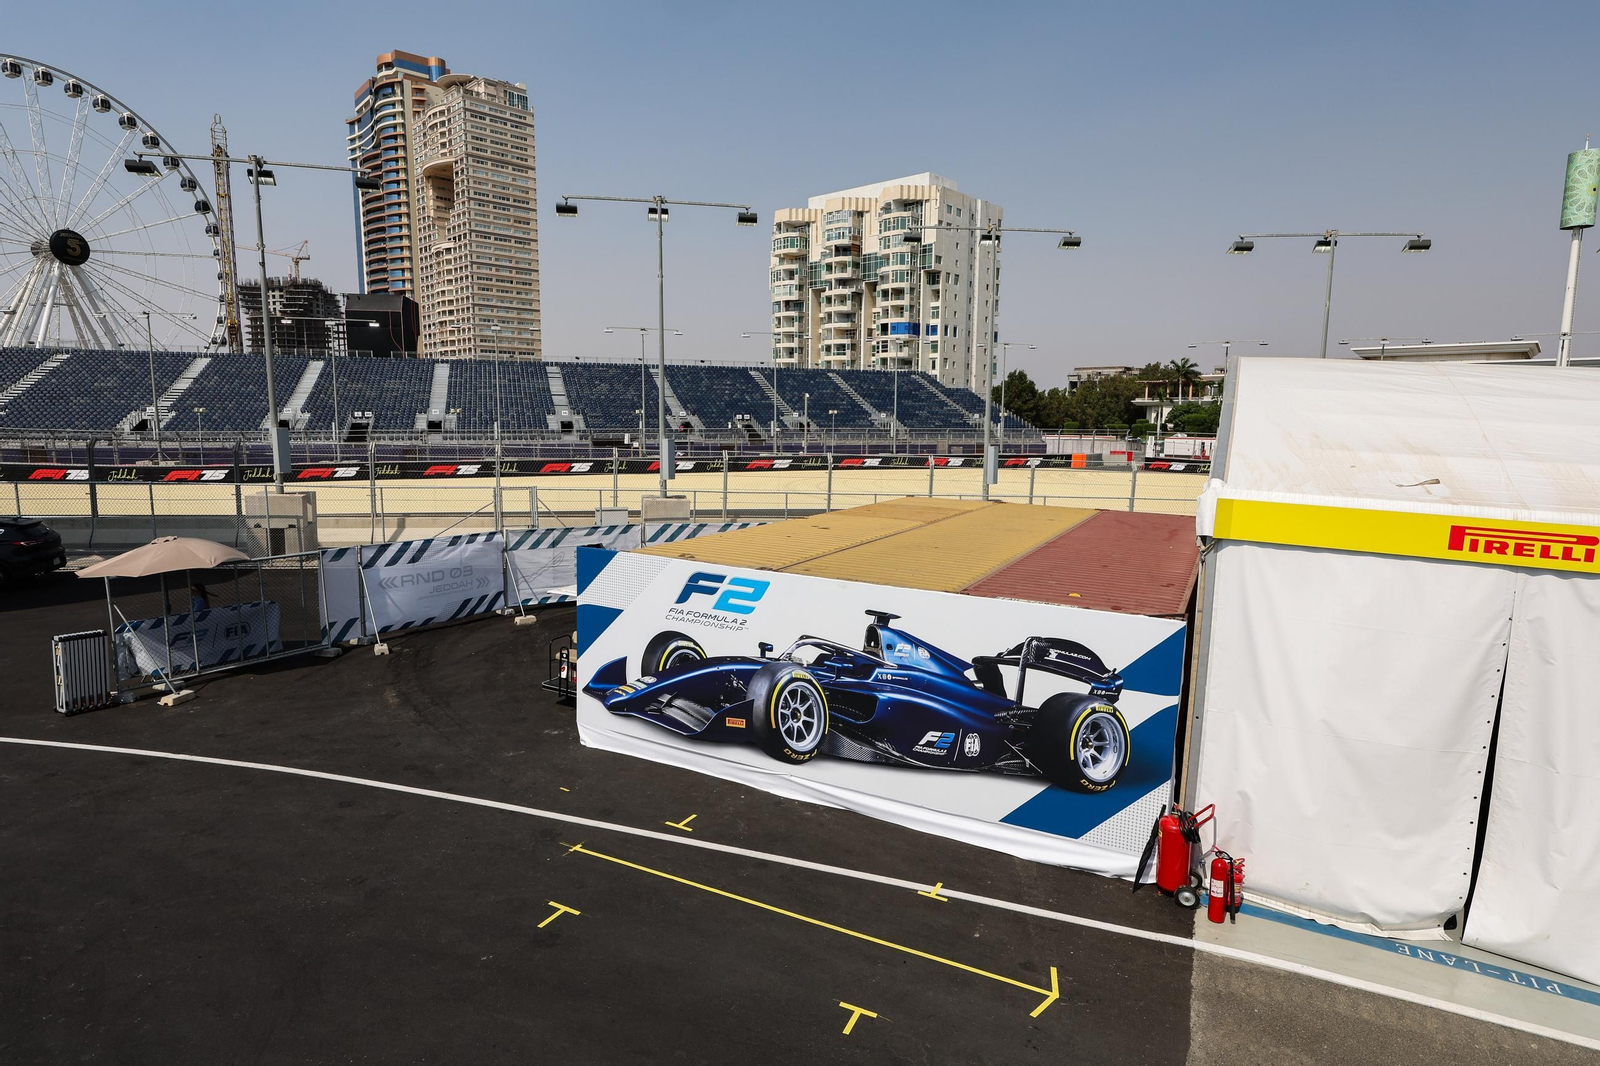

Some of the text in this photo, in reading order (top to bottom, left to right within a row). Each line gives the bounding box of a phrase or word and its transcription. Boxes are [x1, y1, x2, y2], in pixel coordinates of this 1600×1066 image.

[1448, 525, 1600, 563] PIRELLI
[401, 570, 445, 587] RND
[429, 580, 473, 594] JEDDAH
[674, 571, 771, 615] F2
[665, 614, 744, 632] CHAMPIONSHIP
[668, 607, 684, 616] FIA
[686, 610, 741, 625] FORMULA
[918, 731, 956, 749] F2
[1396, 943, 1564, 995] PIT-LANE
